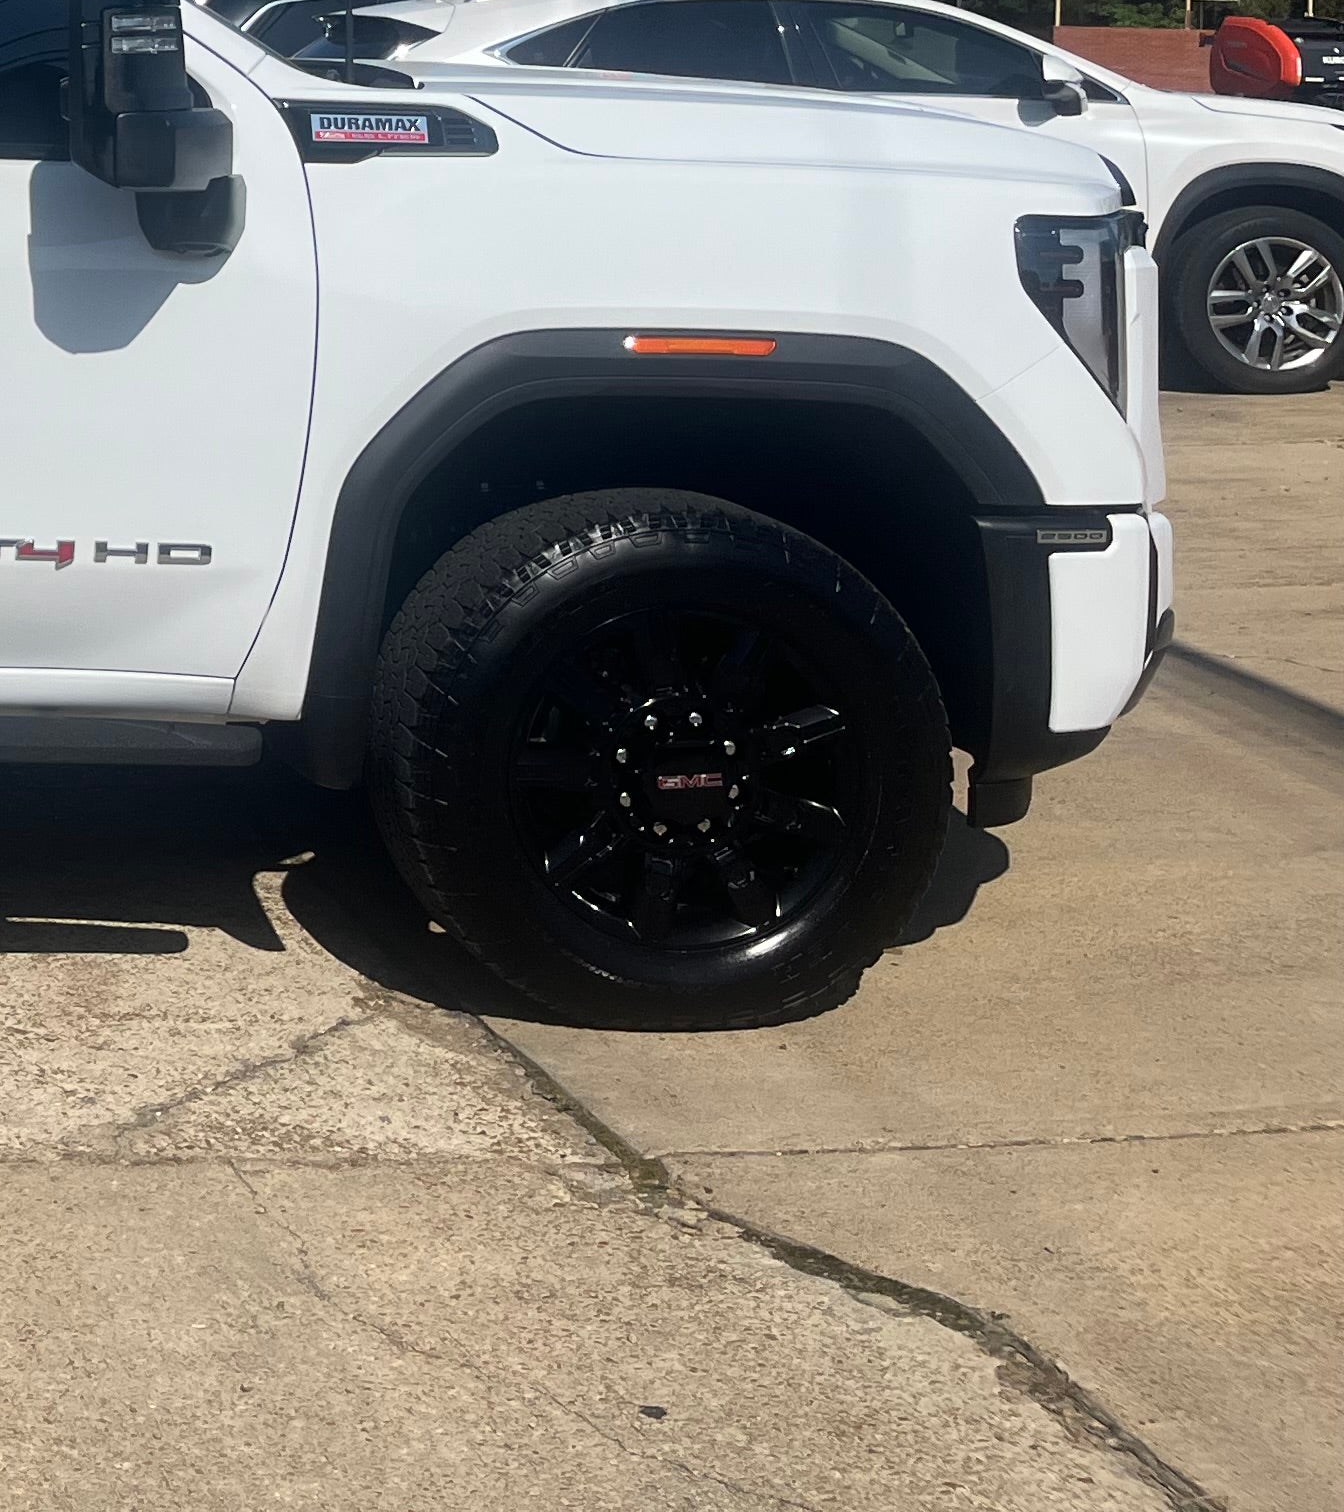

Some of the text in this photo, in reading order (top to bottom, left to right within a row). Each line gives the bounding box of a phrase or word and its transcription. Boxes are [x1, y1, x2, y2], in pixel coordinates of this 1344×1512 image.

[319, 116, 421, 132] DURAMAX
[94, 540, 212, 565] HD
[657, 773, 723, 789] GMC
